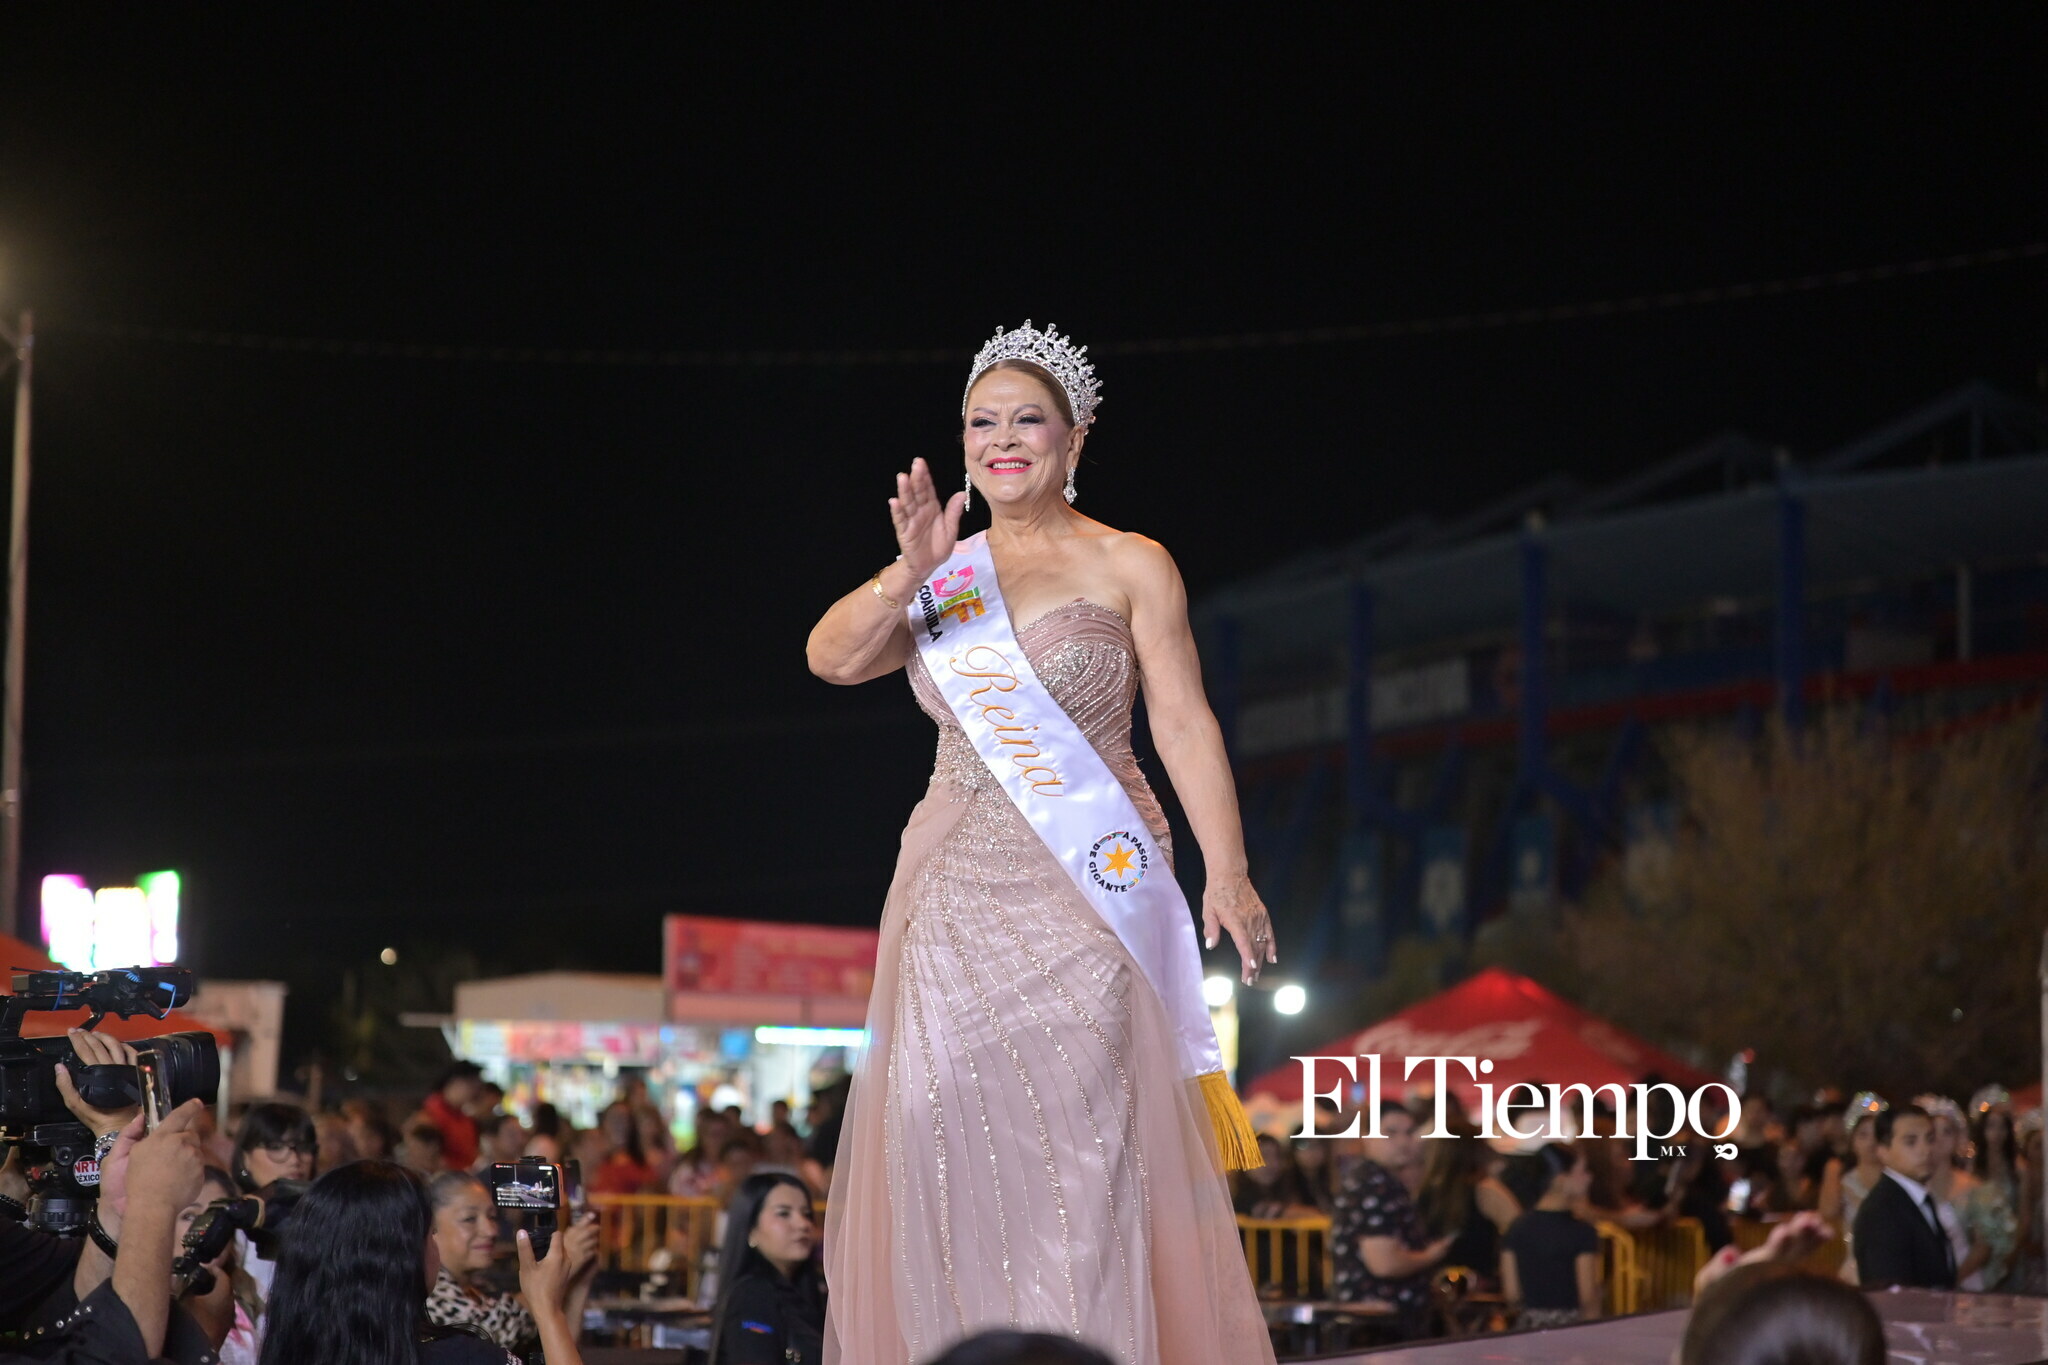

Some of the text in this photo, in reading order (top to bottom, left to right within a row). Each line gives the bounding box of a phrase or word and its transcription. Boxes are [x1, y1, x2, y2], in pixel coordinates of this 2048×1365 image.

[918, 585, 943, 642] COAHUILA
[932, 565, 986, 623] DIF
[949, 646, 1064, 797] Reina
[1089, 843, 1101, 858] DE
[1131, 836, 1148, 869] PASOS
[1089, 861, 1127, 893] GIGANTE
